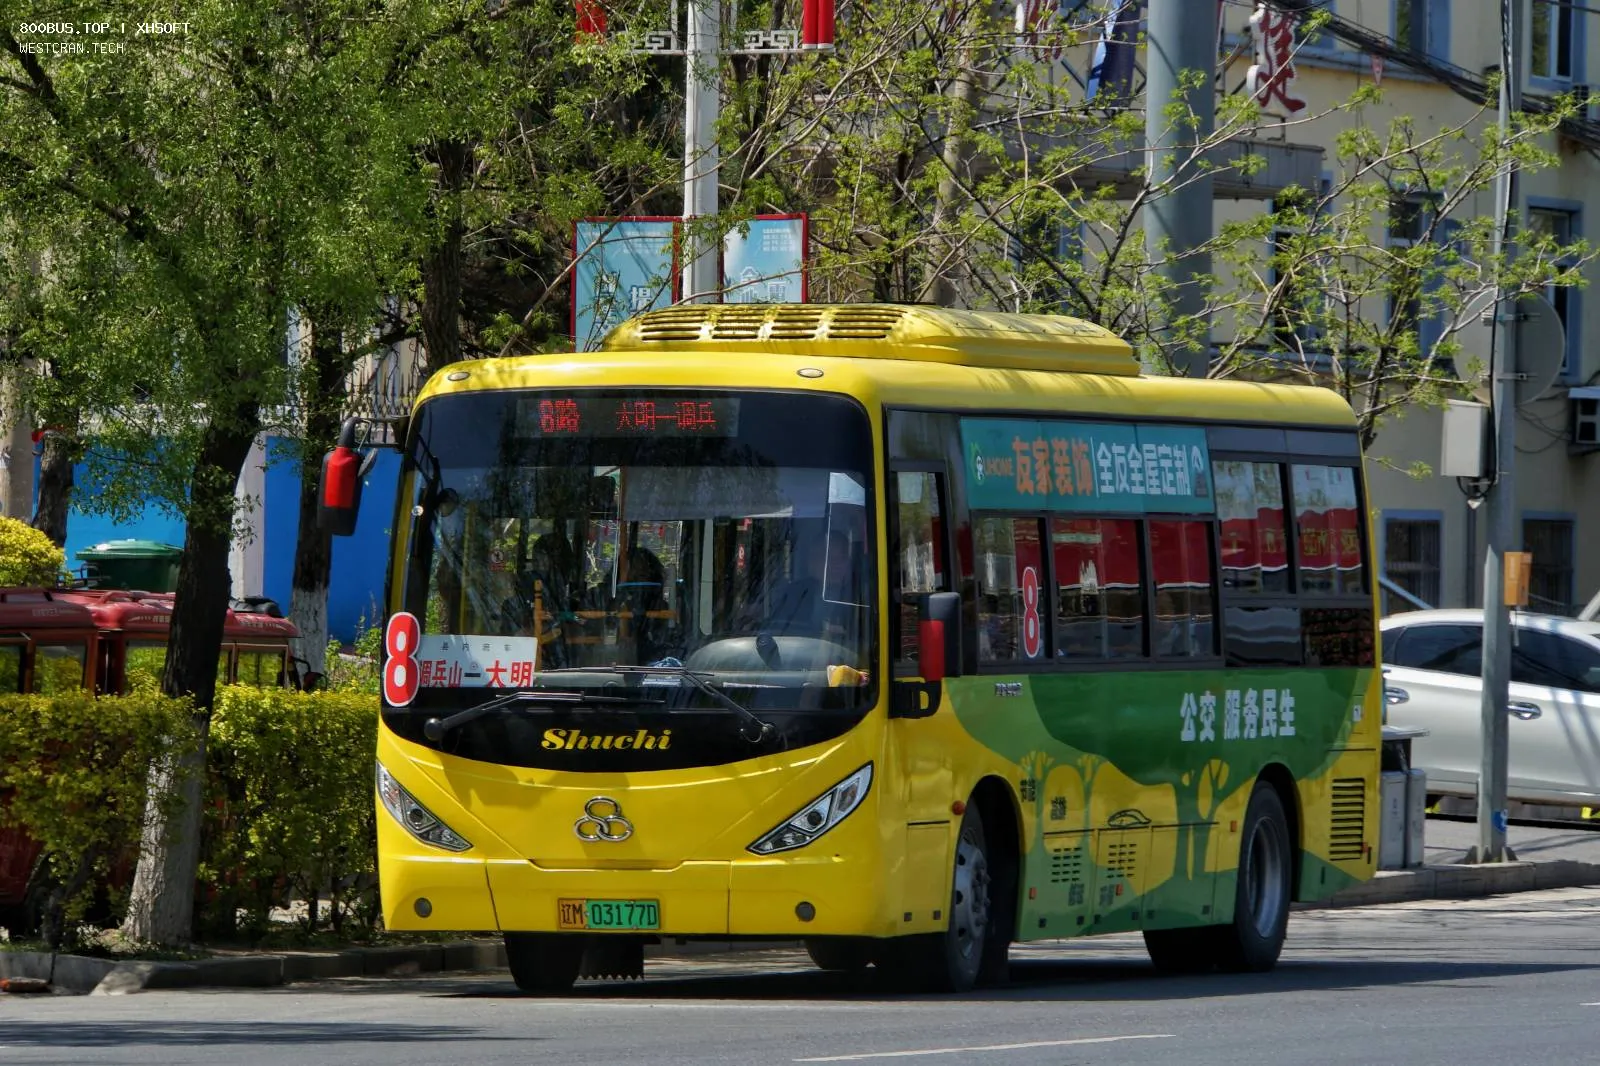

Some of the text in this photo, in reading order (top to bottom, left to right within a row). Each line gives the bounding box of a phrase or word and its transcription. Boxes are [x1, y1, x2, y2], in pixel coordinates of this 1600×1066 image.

[1022, 566, 1041, 659] 8
[384, 611, 420, 707] 8
[540, 727, 672, 751] Shuchi
[1179, 686, 1297, 743] 公交 服务民生
